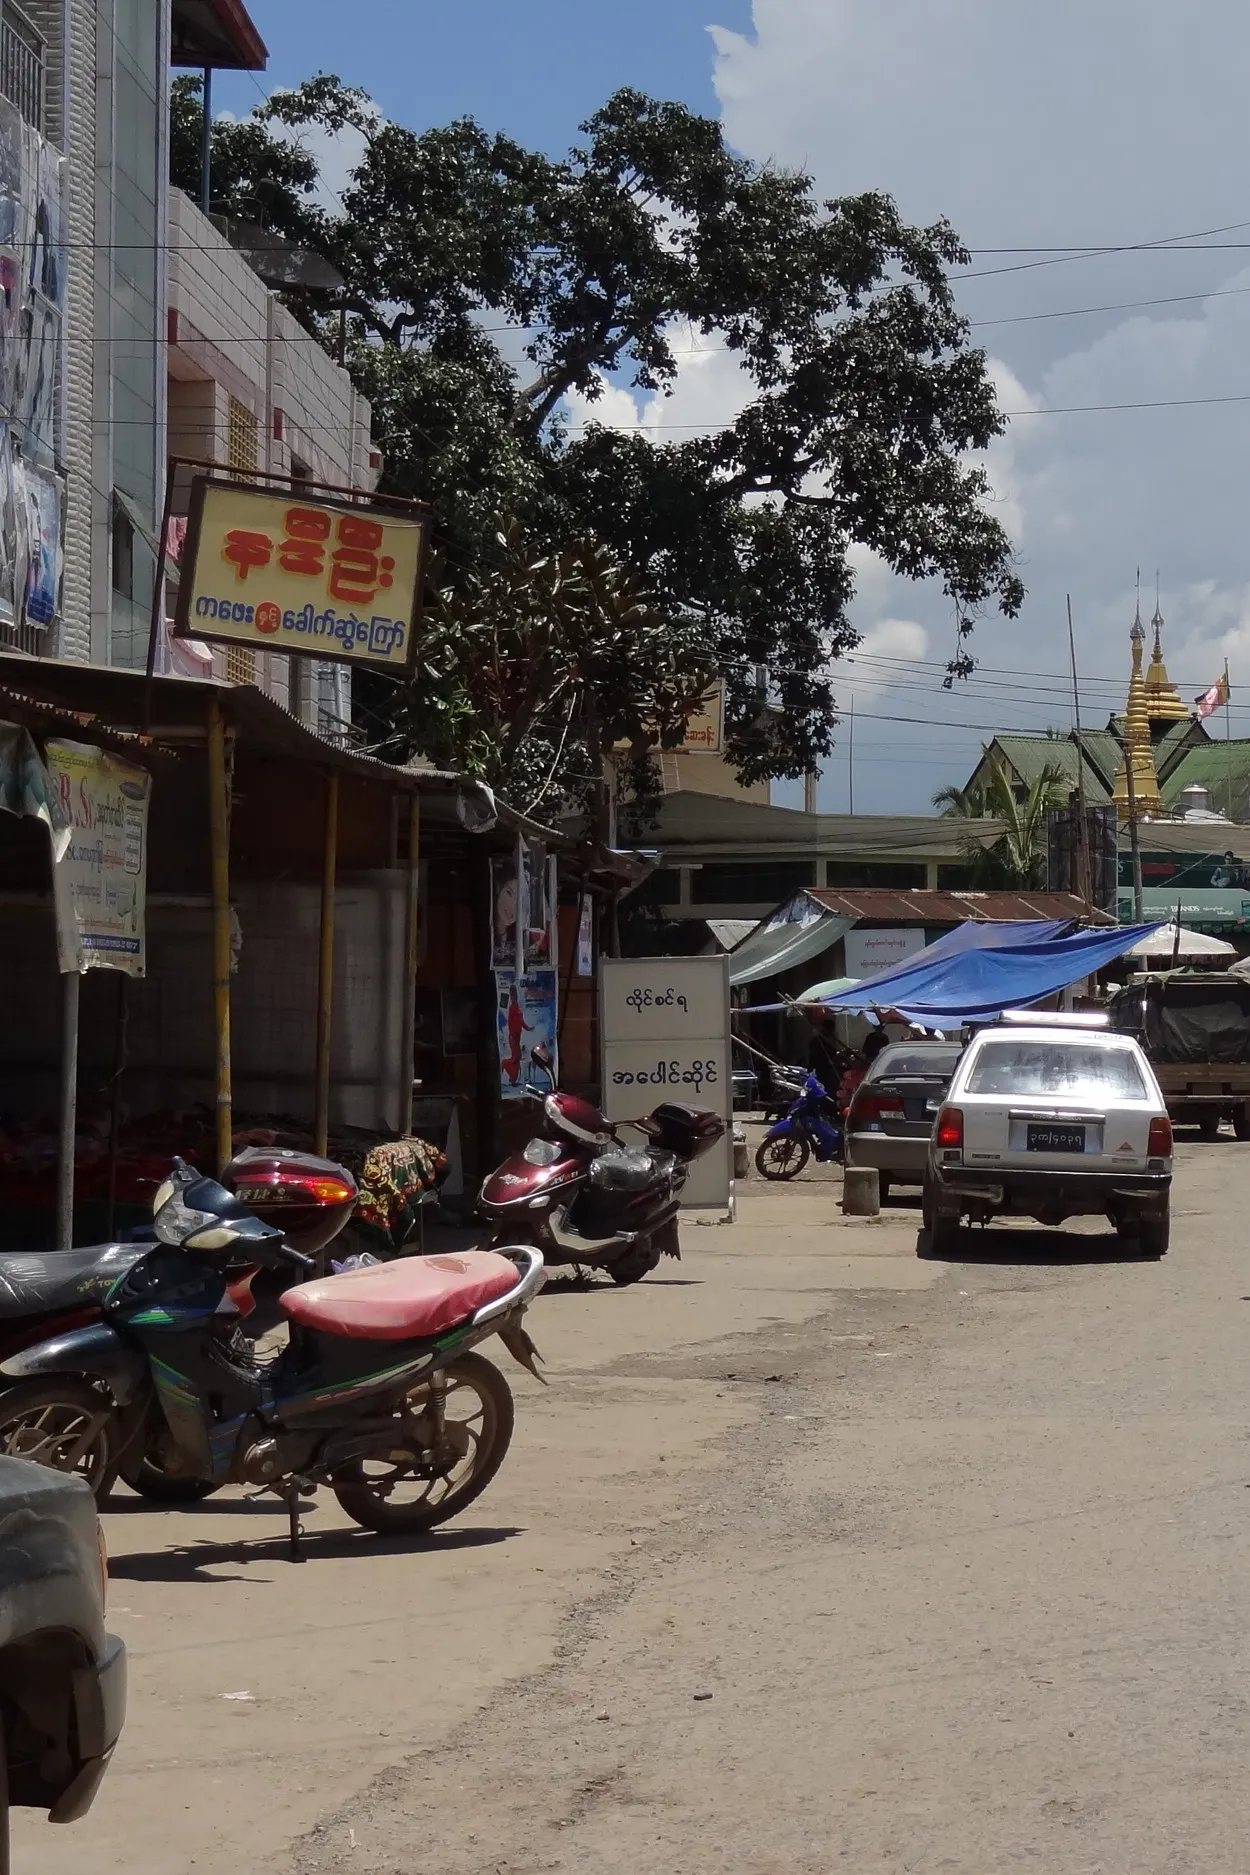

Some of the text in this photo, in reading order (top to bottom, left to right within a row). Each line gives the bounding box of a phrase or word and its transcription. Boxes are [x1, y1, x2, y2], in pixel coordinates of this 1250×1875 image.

[282, 603, 406, 655] ခေါက်ဆွဲကြော်
[626, 988, 688, 1013] လိုင်စင်ရ
[612, 1060, 718, 1094] အပေါင်ဆိုင်
